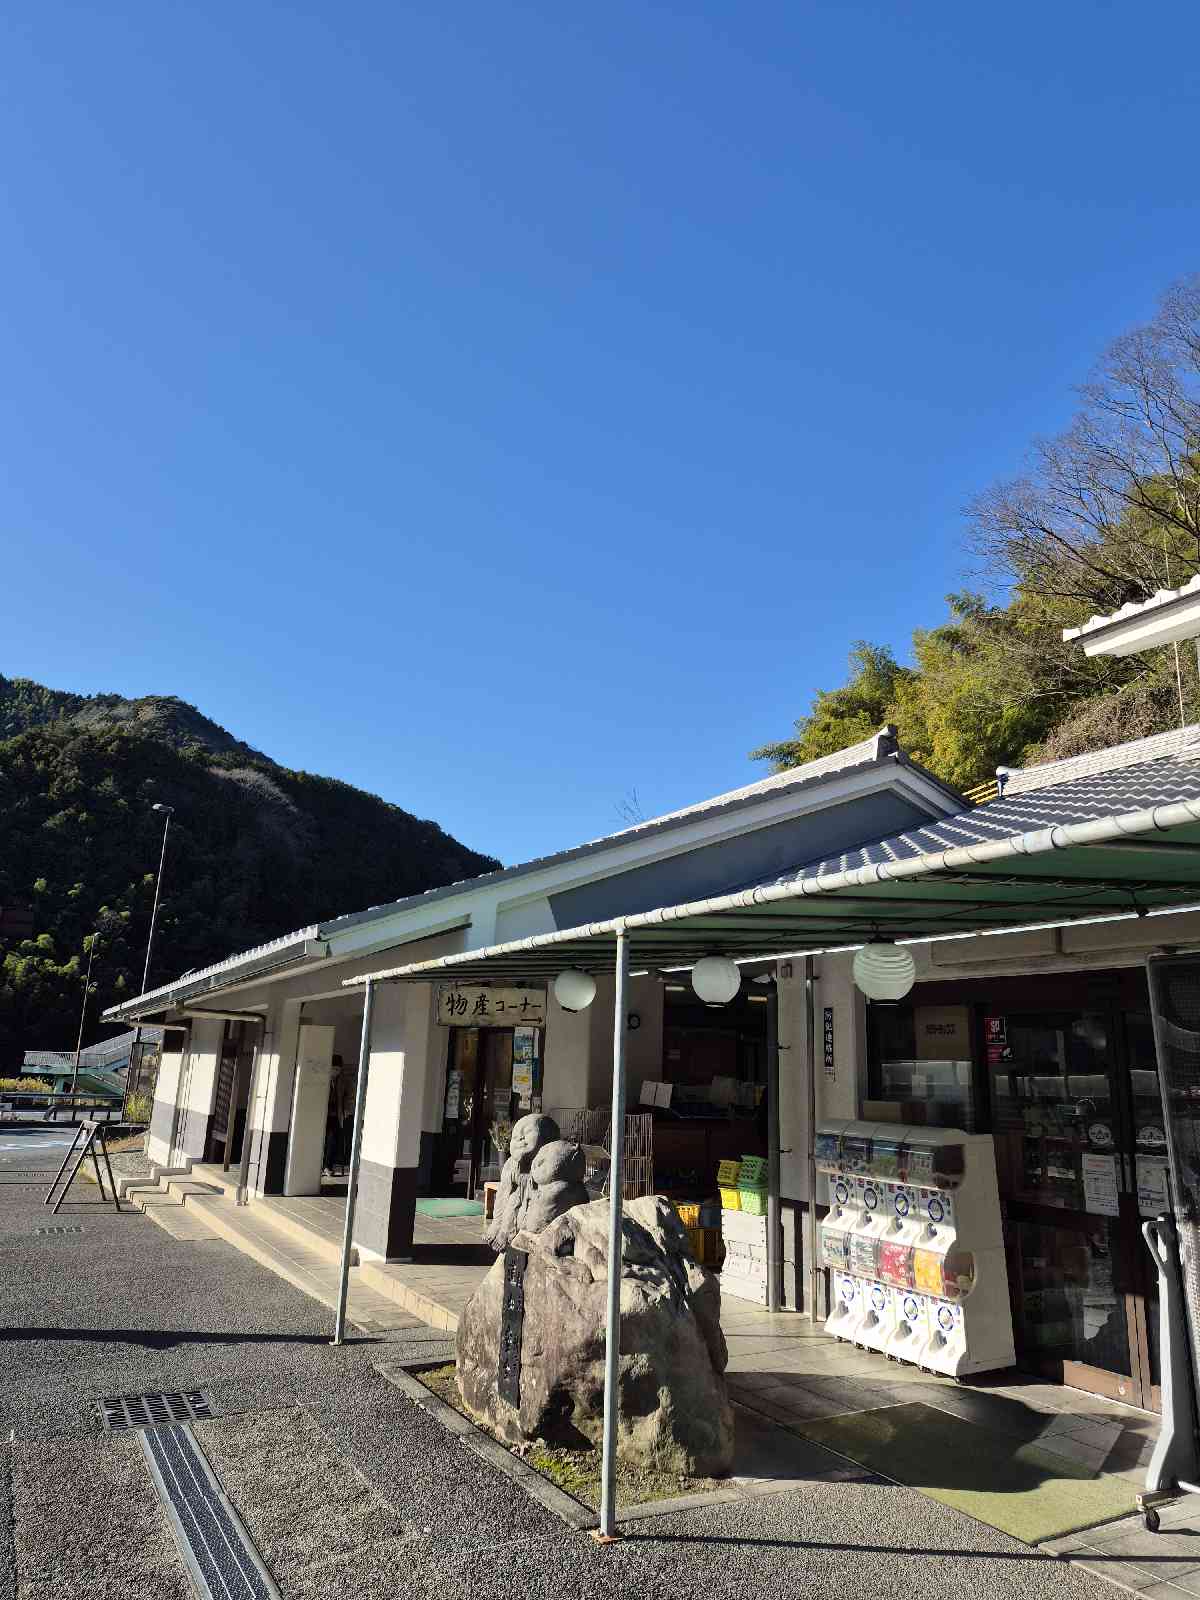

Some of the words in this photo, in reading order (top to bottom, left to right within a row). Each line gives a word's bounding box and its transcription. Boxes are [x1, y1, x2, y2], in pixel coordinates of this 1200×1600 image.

[446, 992, 542, 1017] 物産コーナー
